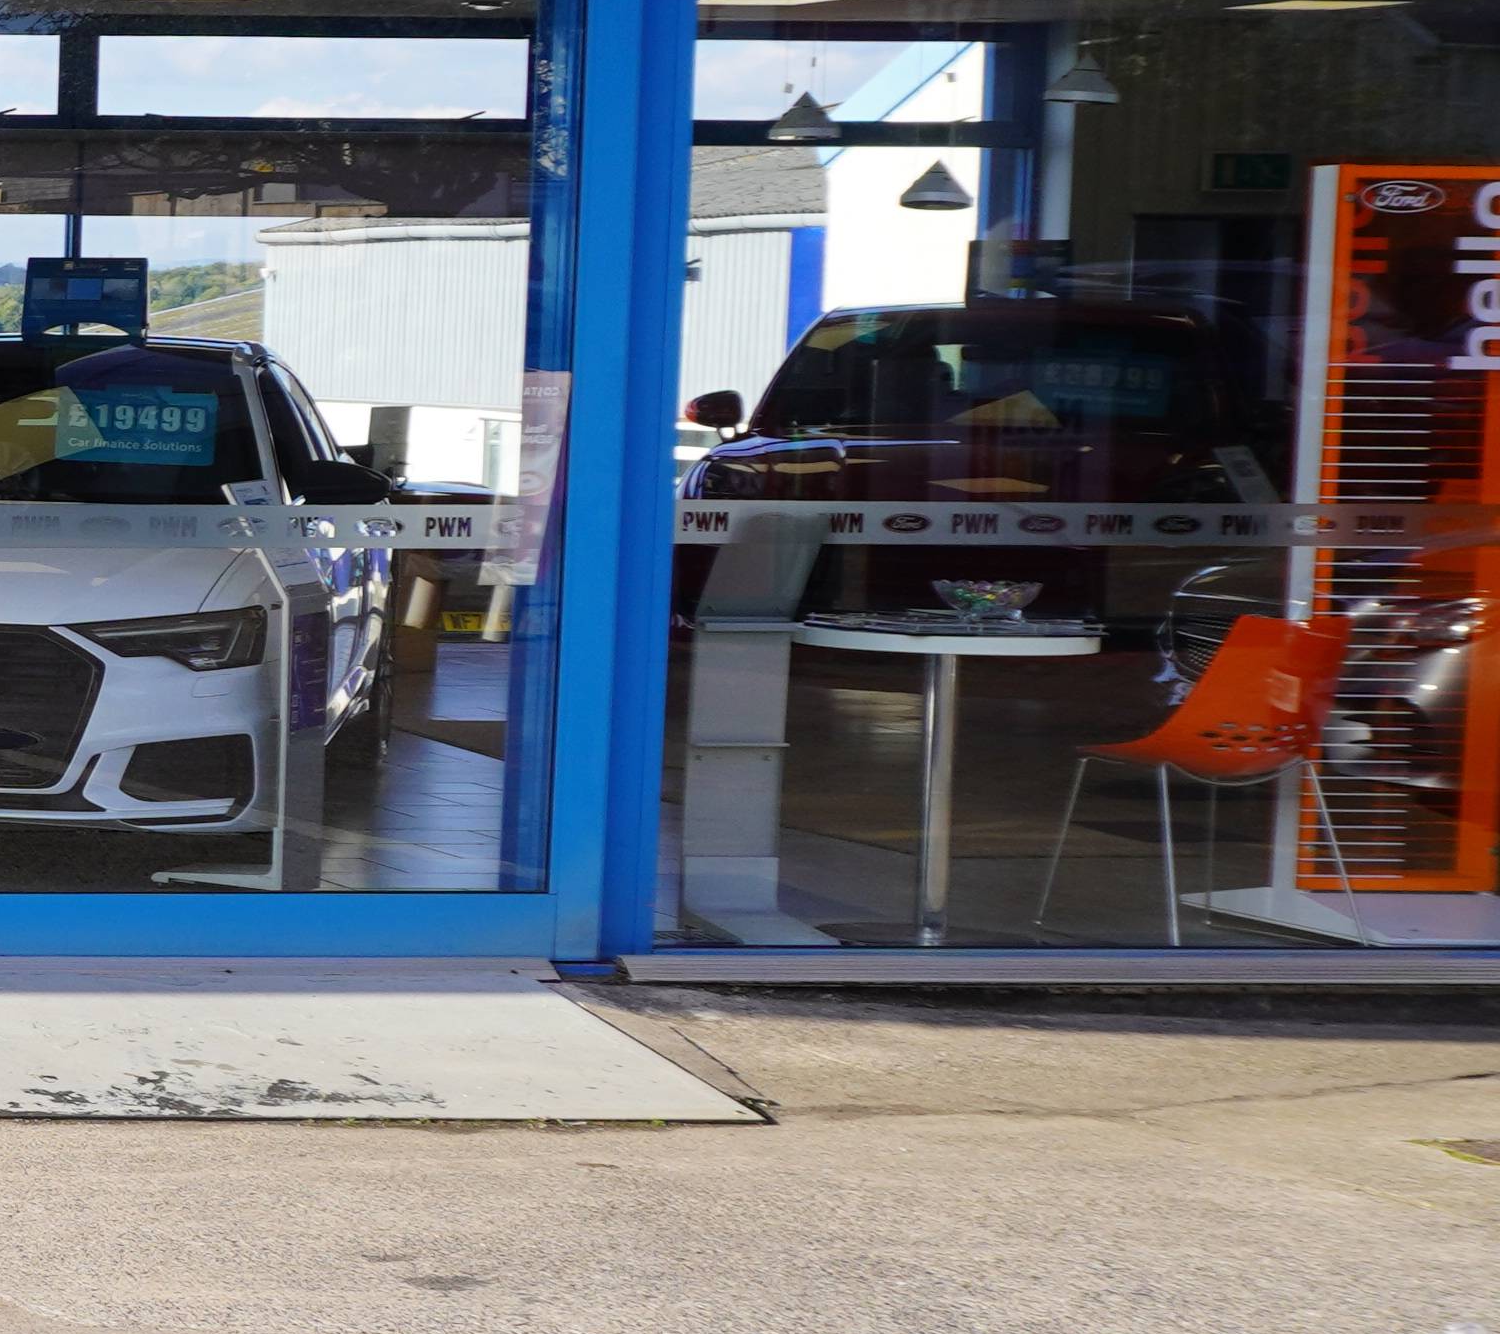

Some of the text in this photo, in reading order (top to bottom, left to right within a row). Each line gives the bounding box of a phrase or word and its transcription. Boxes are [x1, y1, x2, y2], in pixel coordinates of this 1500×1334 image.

[1368, 181, 1438, 210] Ford
[68, 403, 207, 433] £19499
[67, 437, 90, 448] Car
[93, 438, 141, 450] finance
[425, 516, 473, 538] PWM
[681, 512, 729, 533] PWM
[951, 513, 999, 534] PWM
[1085, 514, 1133, 536] PWM
